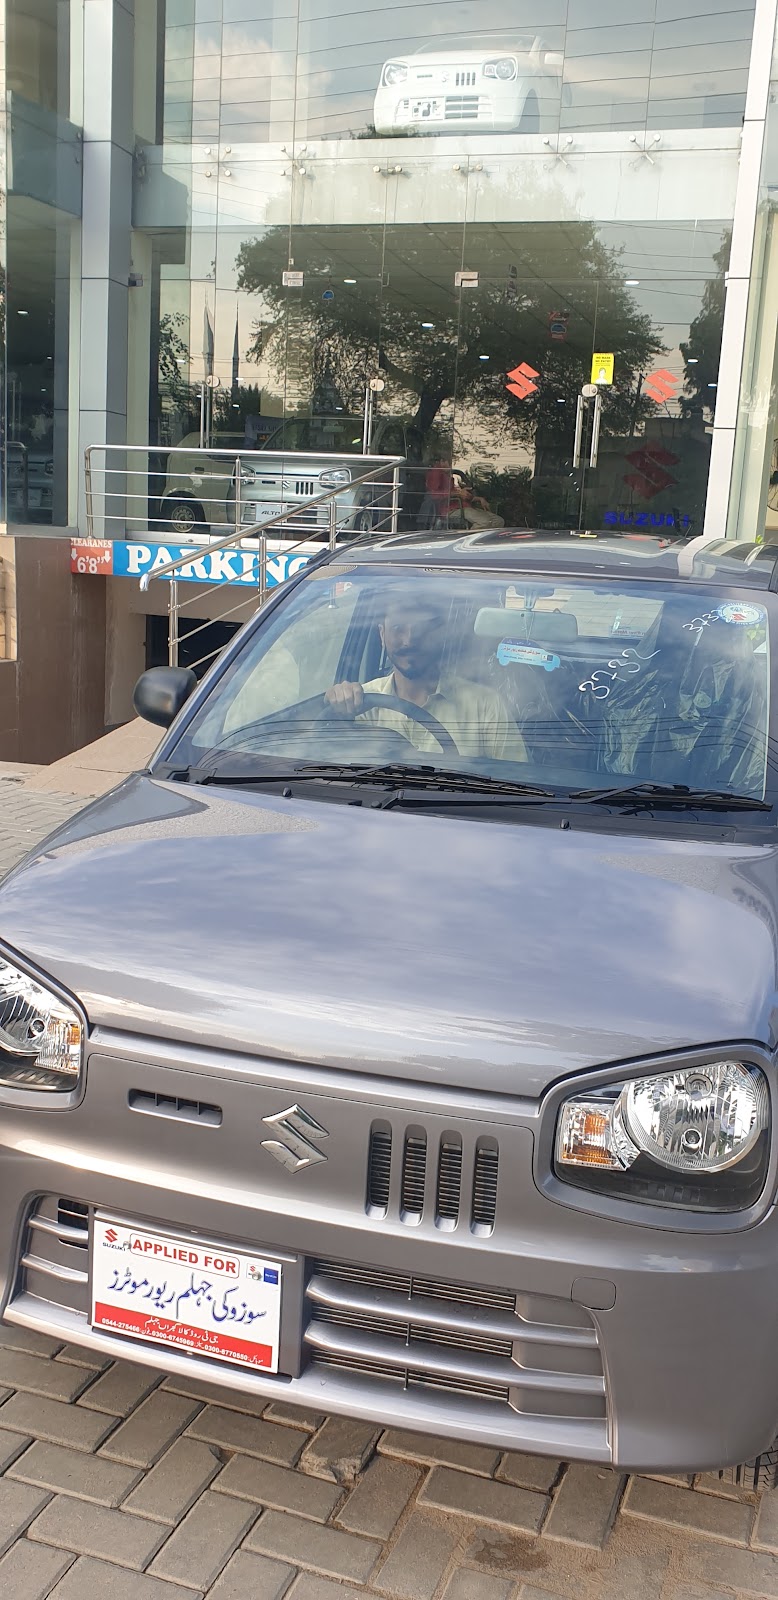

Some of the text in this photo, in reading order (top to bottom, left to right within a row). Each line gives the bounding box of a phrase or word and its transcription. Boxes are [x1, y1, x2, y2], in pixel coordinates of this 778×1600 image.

[578, 648, 661, 699] 3732
[102, 1242, 126, 1252] SUZUKI
[132, 1239, 237, 1274] APPLIED FOR
